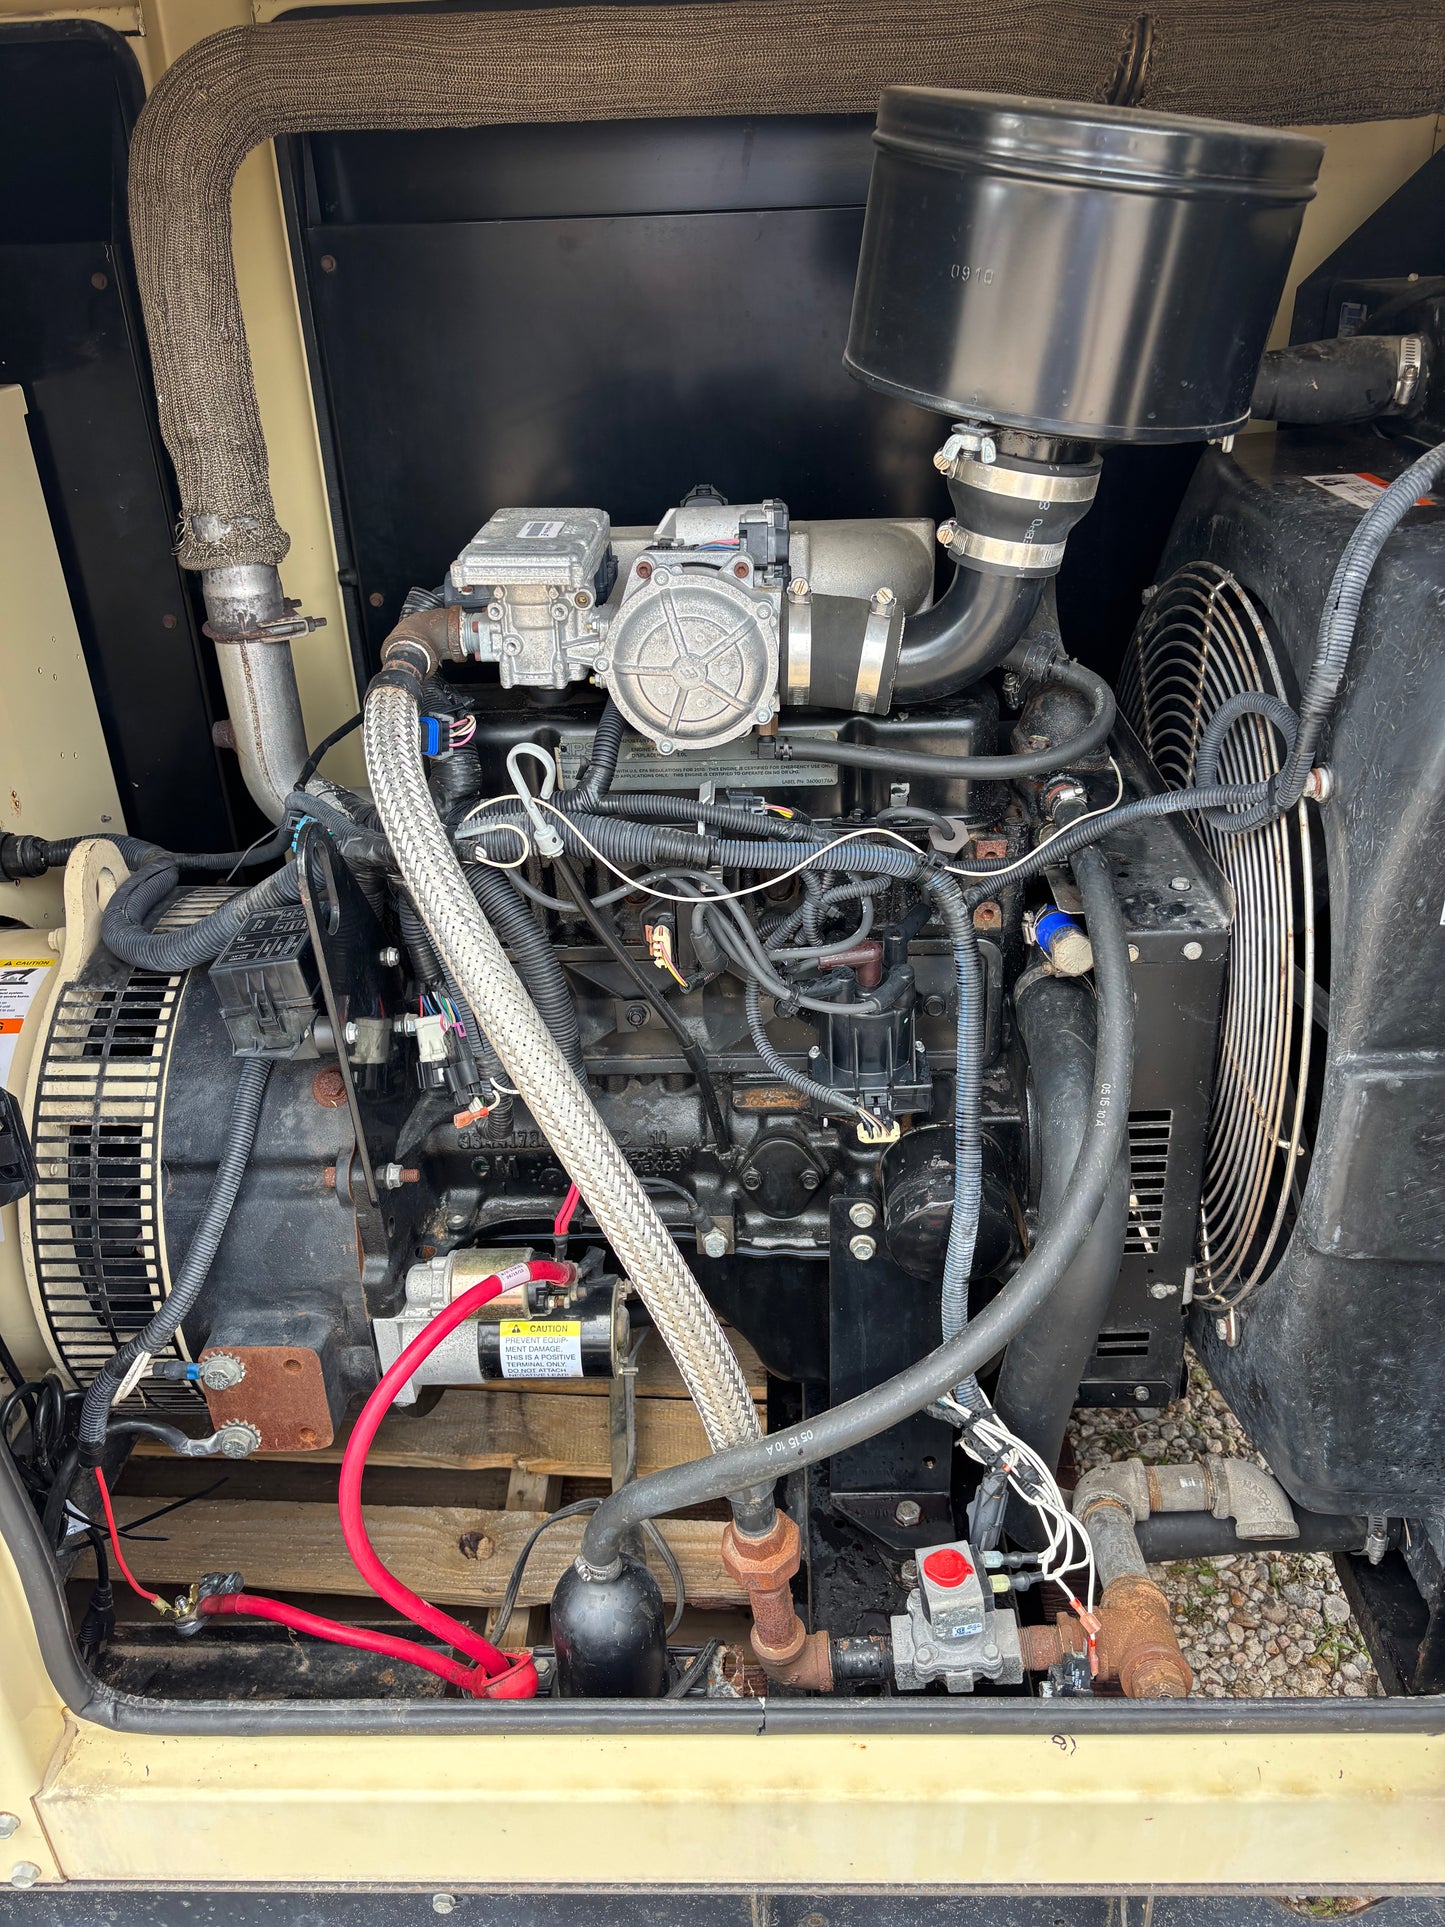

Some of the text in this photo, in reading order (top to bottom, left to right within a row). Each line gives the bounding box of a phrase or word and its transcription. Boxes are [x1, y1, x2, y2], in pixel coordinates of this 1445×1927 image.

[950, 264, 994, 286] 0910
[1100, 1083, 1112, 1095] 05
[1099, 1096, 1111, 1107] 15
[1096, 1109, 1107, 1119] 10
[470, 1155, 520, 1179] GM
[529, 1324, 568, 1333] CAUTION
[505, 1336, 569, 1344] PREVENT EQUIP-
[540, 1353, 576, 1361] POSITIVE
[765, 1429, 814, 1456] 05 15 10 A
